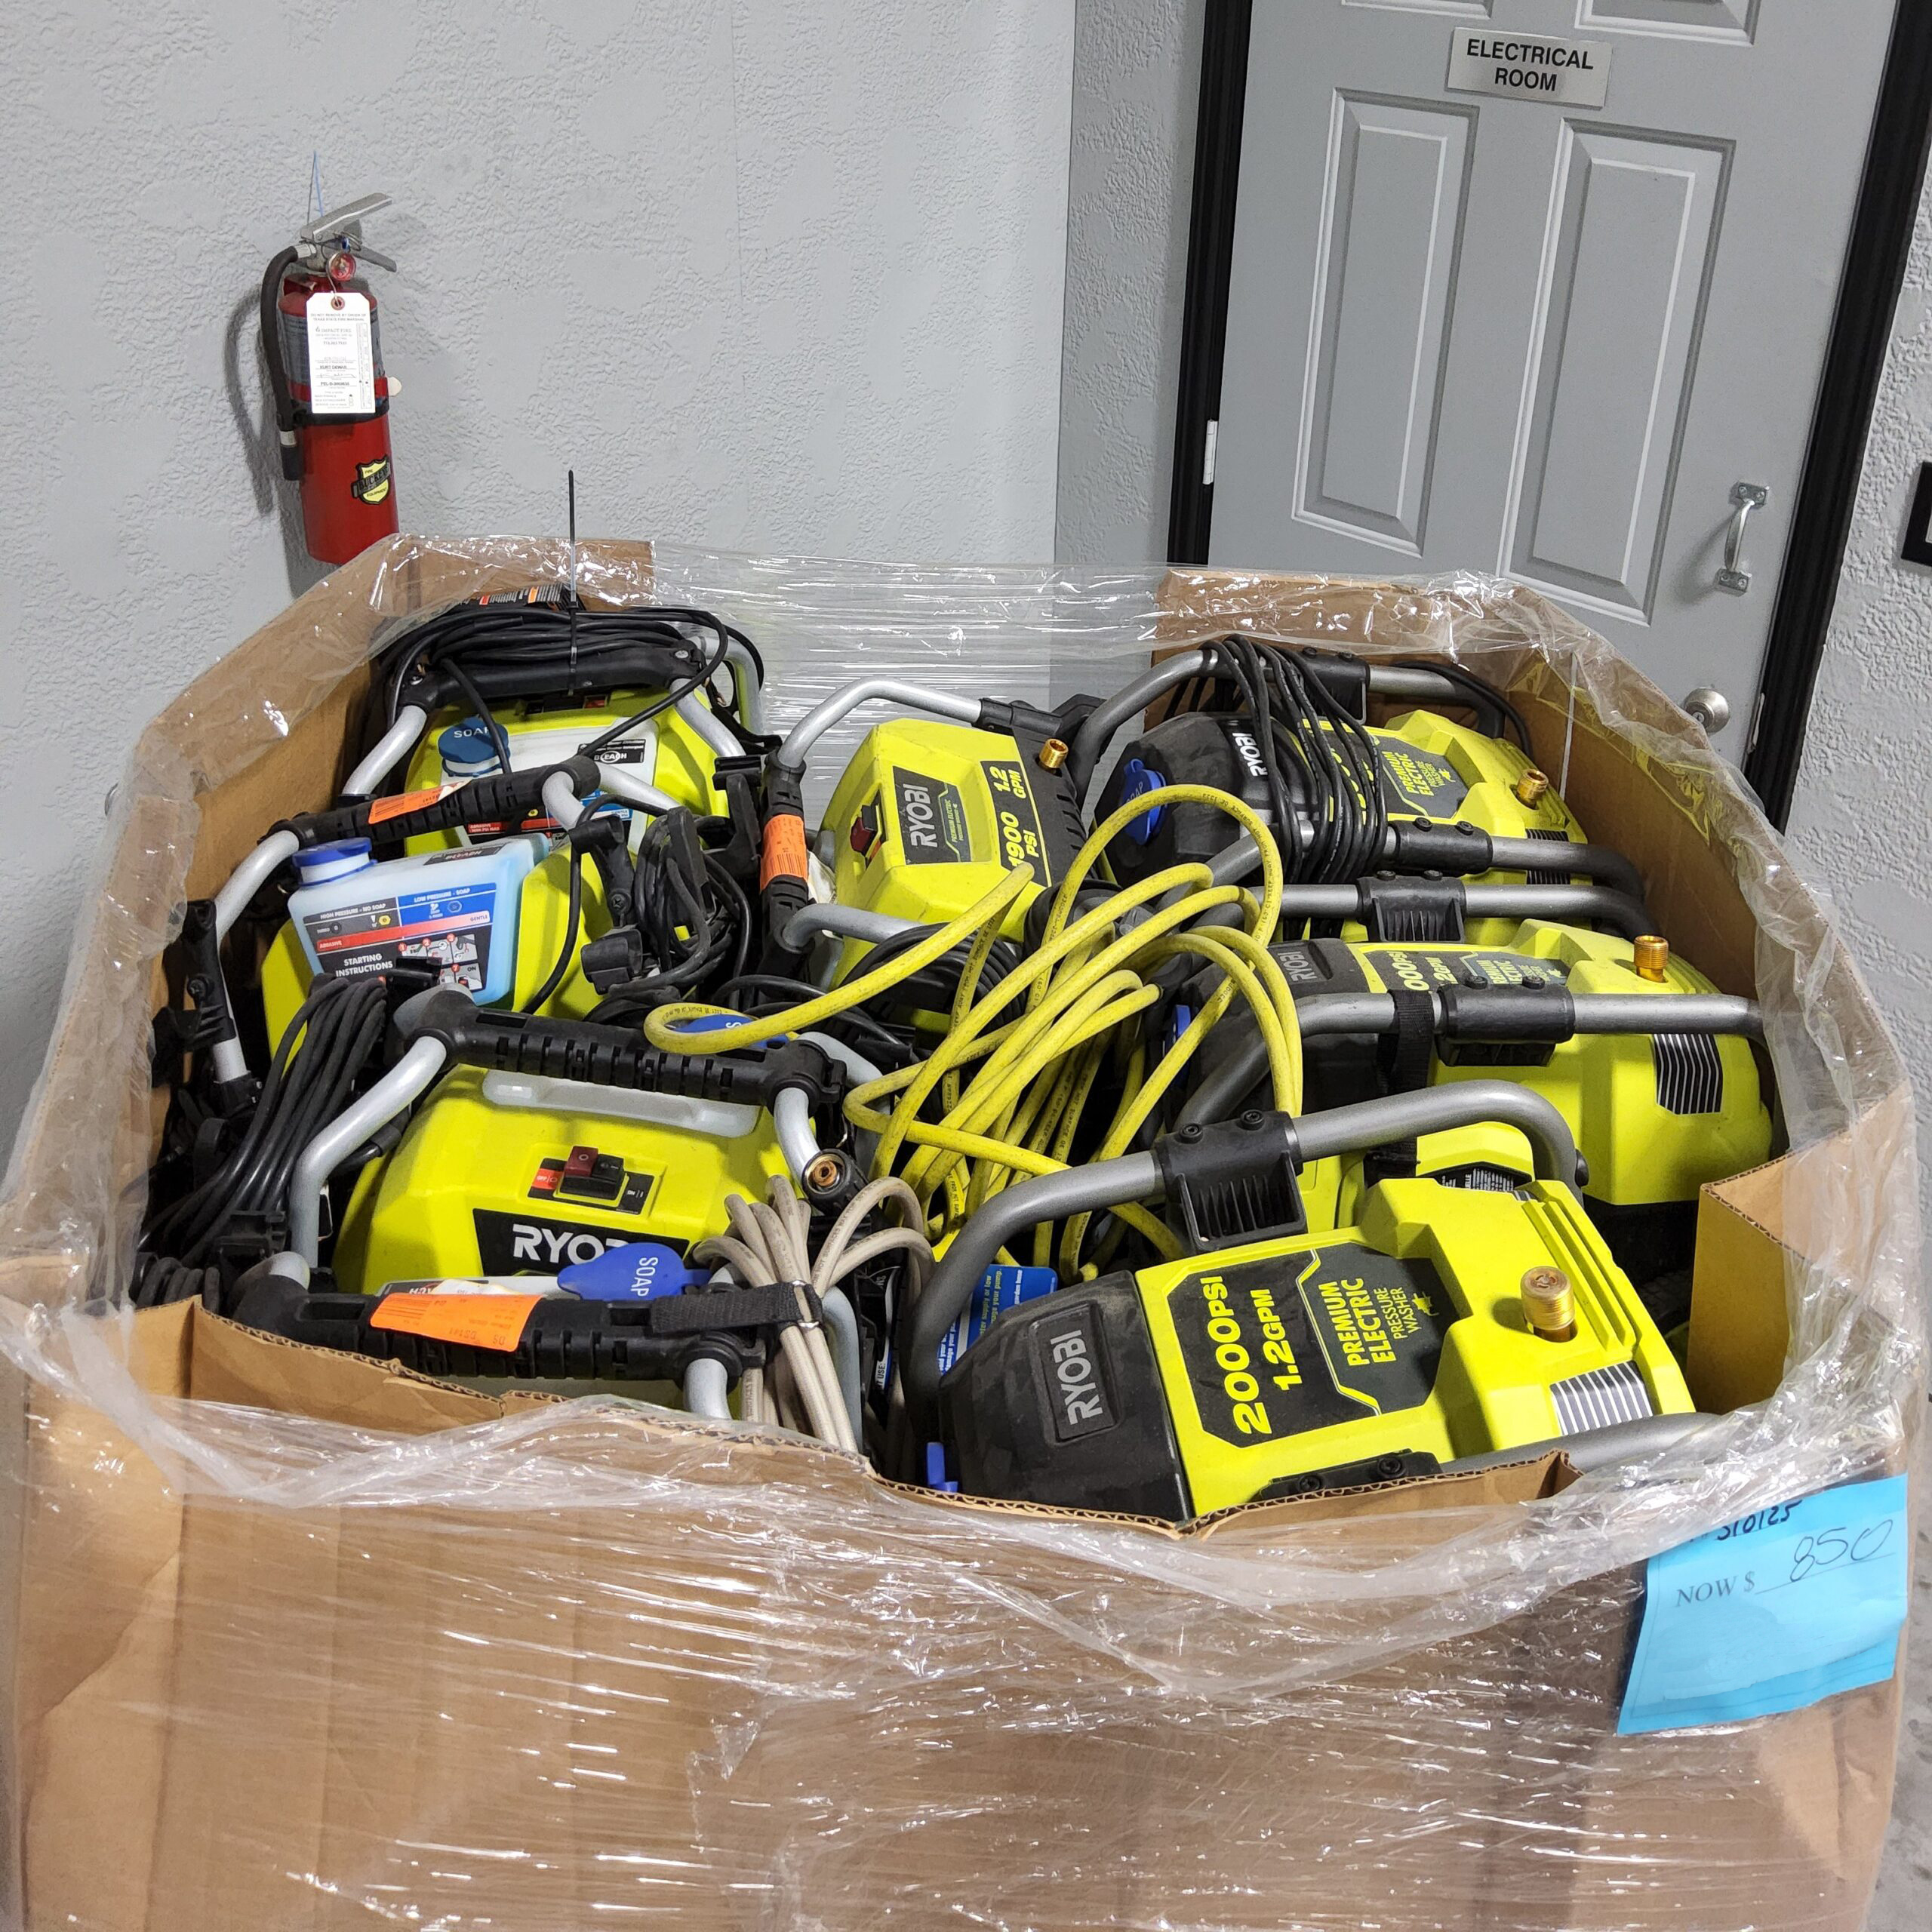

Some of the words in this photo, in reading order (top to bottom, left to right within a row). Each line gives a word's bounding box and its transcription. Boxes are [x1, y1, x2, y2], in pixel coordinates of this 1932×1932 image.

[1467, 38, 1594, 69] ELECTRICAL
[1495, 67, 1558, 91] ROOM
[1232, 732, 1269, 777] RYOBI
[1381, 751, 1420, 794] PREMIUM
[1394, 752, 1435, 796] ELECTRIC
[989, 767, 1011, 792] 1.2
[1008, 770, 1027, 799] GPM
[903, 783, 938, 848] RYOBI
[1000, 811, 1026, 867] 1900
[1023, 829, 1040, 858] PSI
[470, 914, 488, 922] GENTLE
[335, 961, 393, 977] INSTRUCTIONS
[343, 953, 383, 967] STARTING
[1276, 951, 1318, 982] RYOBI
[1387, 951, 1430, 991] 000PSI
[1425, 957, 1459, 984] 2GPM
[1476, 960, 1509, 984] REMIUM
[512, 1223, 629, 1266] RYO
[630, 1257, 659, 1297] SOAP
[1318, 1281, 1371, 1367] PREMIUM
[1341, 1278, 1397, 1363] ELECTRIC
[1374, 1287, 1408, 1340] PRESSURE
[1389, 1287, 1422, 1334] WASHER
[1200, 1275, 1272, 1435] 2000PSI
[1250, 1289, 1303, 1391] 1.2GPM
[1050, 1330, 1103, 1426] RYOBI
[1675, 1576, 1737, 1607] NOW
[1744, 1571, 1755, 1593] $
[1790, 1519, 1894, 1582] 850
